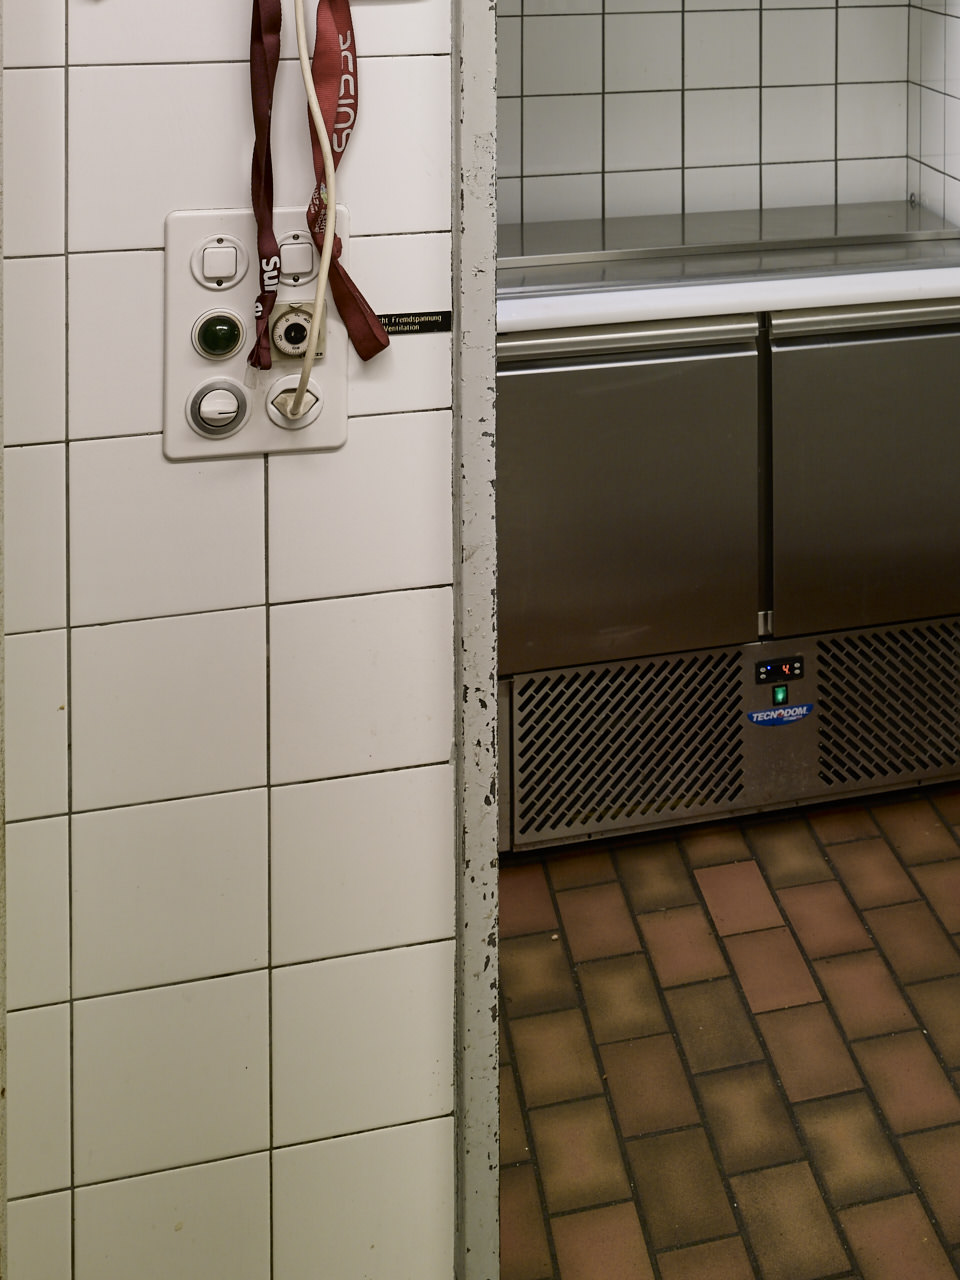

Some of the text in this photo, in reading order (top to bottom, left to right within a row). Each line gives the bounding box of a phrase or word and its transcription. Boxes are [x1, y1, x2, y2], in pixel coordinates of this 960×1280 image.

[391, 315, 442, 324] Fremdspannung
[383, 324, 420, 332] Ventilation
[752, 706, 807, 722] TECNODOM
